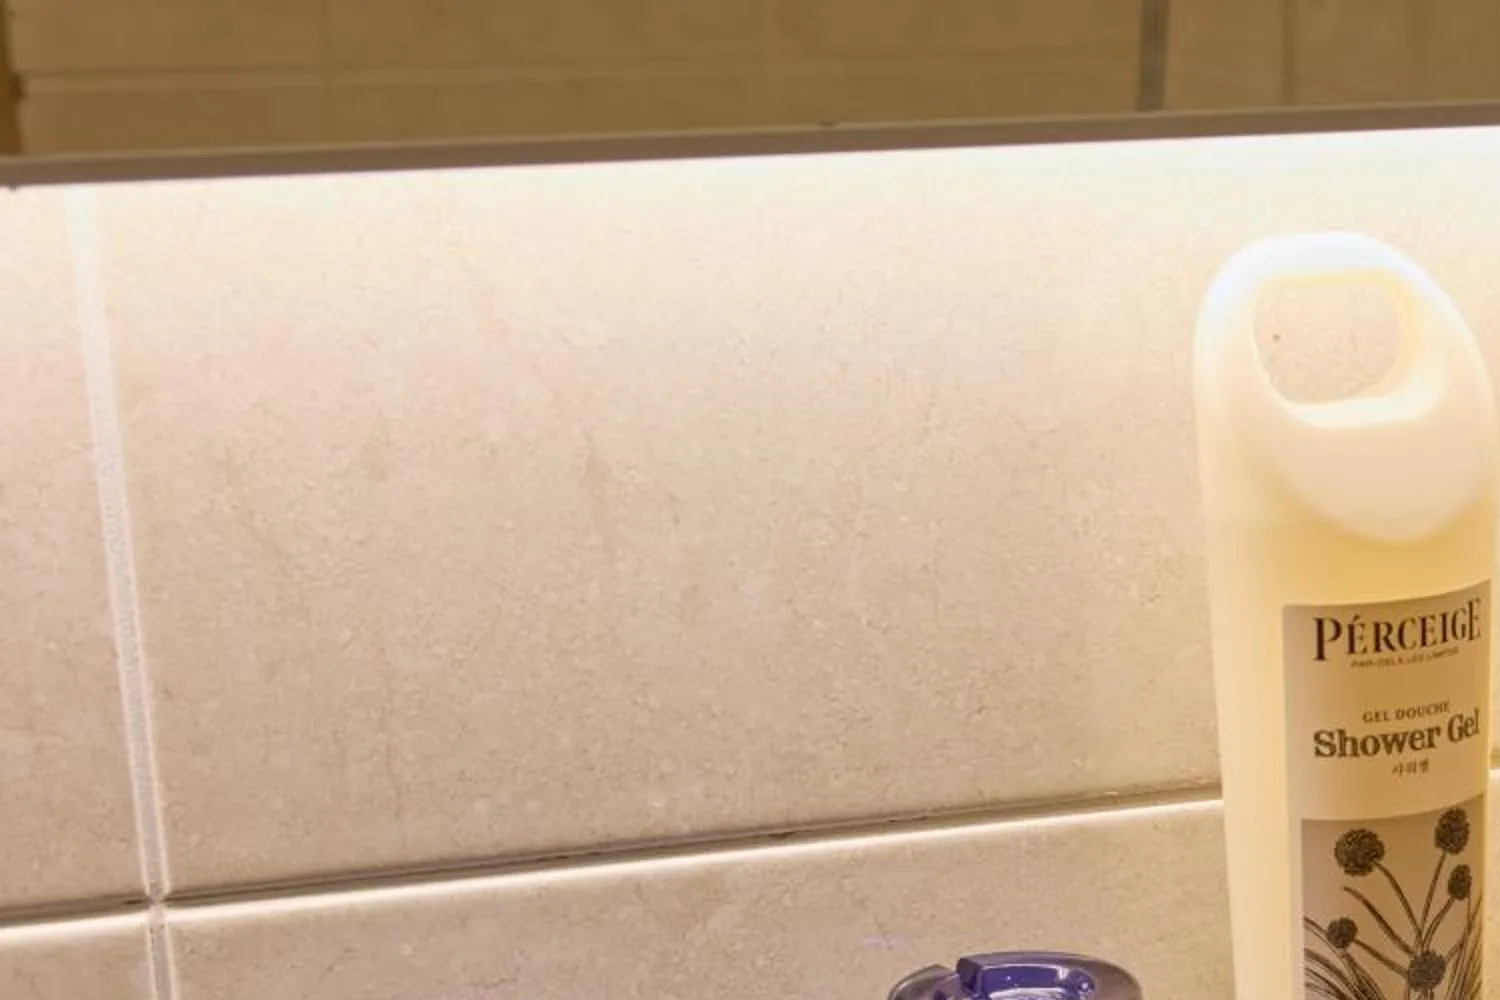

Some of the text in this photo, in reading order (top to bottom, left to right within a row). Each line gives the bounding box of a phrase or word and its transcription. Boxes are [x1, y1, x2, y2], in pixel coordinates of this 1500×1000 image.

[1312, 597, 1482, 661] PÉRCEIGE
[1313, 707, 1480, 758] Shower Gel
[1363, 709, 1389, 723] GEL
